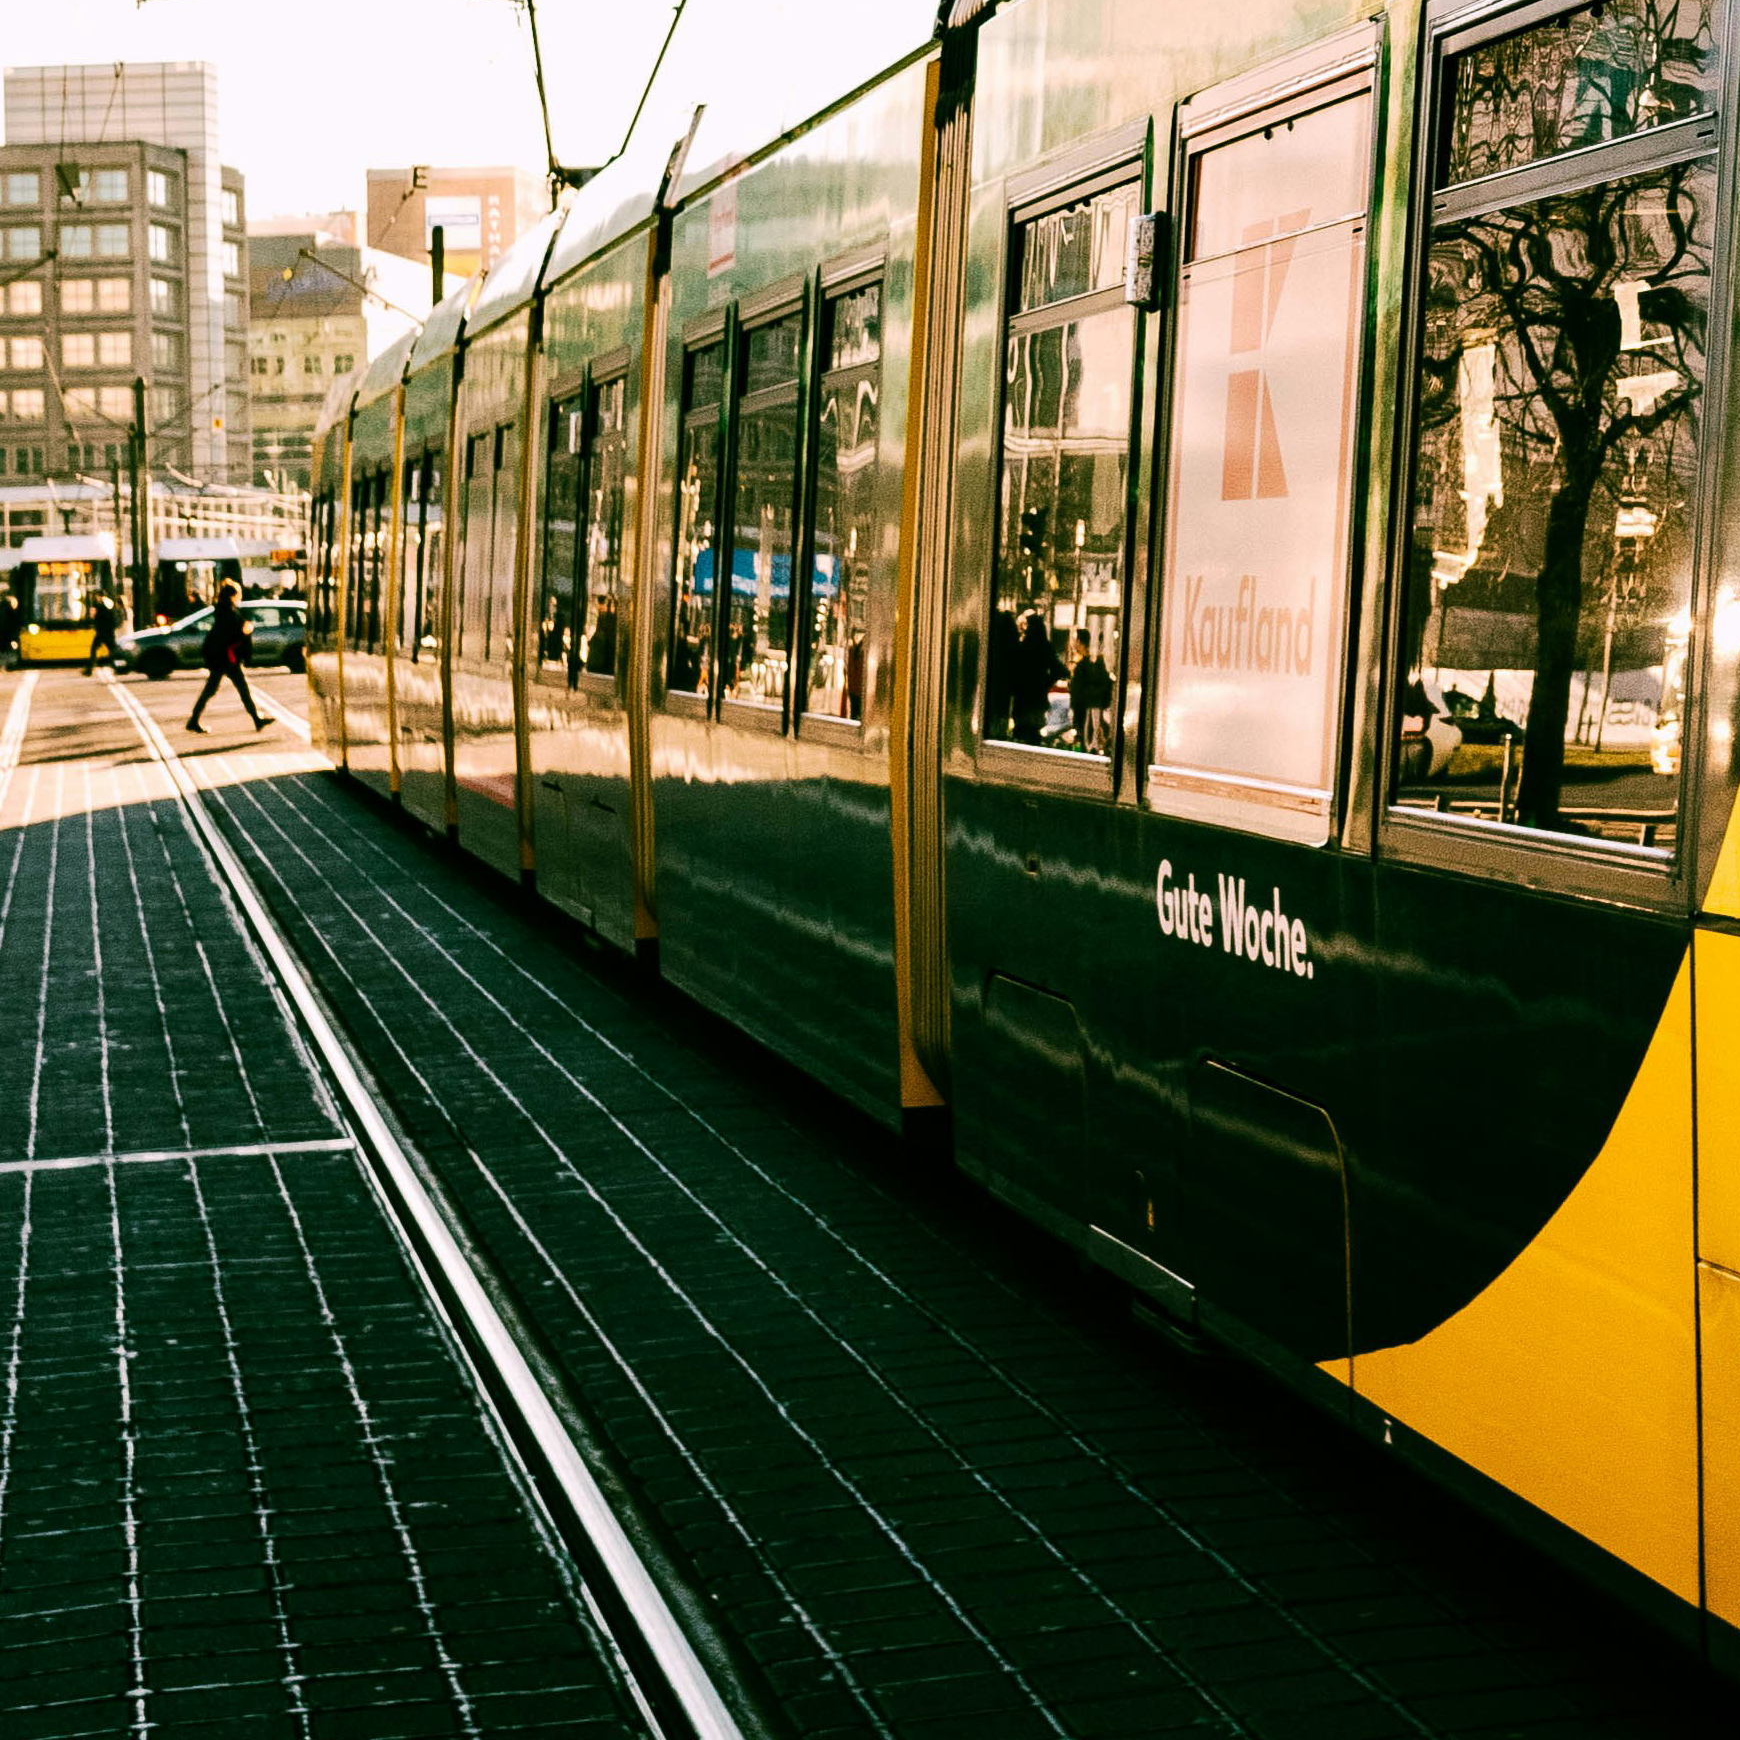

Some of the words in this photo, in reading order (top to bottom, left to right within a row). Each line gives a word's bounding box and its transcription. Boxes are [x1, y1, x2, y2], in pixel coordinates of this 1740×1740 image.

[1181, 574, 1317, 677] Kaufland
[1156, 858, 1214, 948] Gute
[1217, 872, 1314, 980] Woche.
